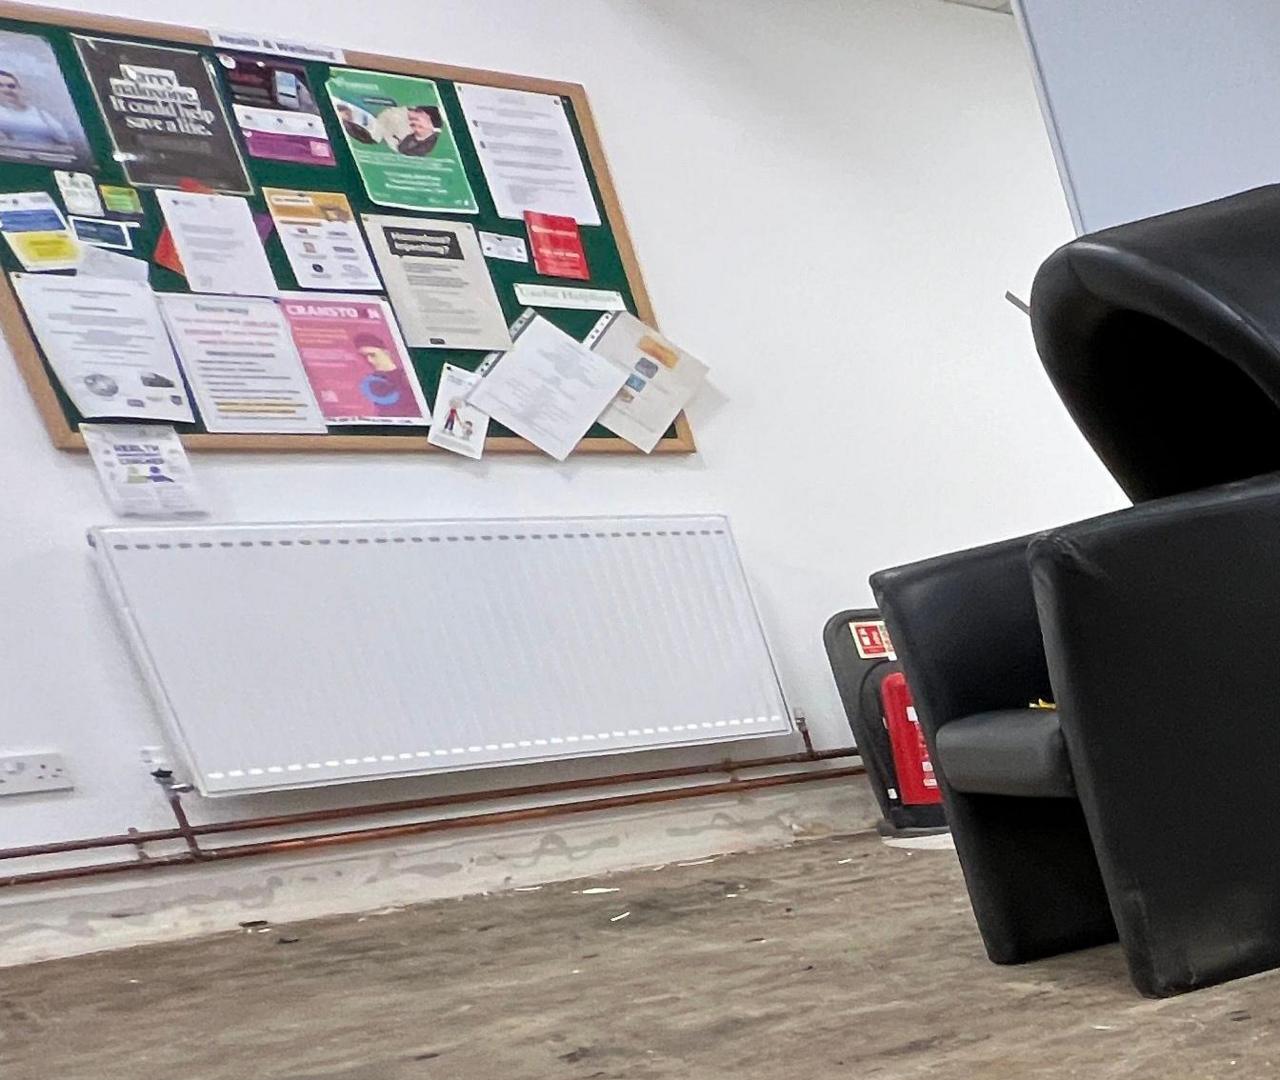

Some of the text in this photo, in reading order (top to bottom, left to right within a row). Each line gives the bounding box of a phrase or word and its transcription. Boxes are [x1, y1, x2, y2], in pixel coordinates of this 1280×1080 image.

[128, 99, 176, 117] could
[177, 102, 215, 125] help
[125, 116, 163, 131] save
[285, 304, 381, 320] CRANSTON
